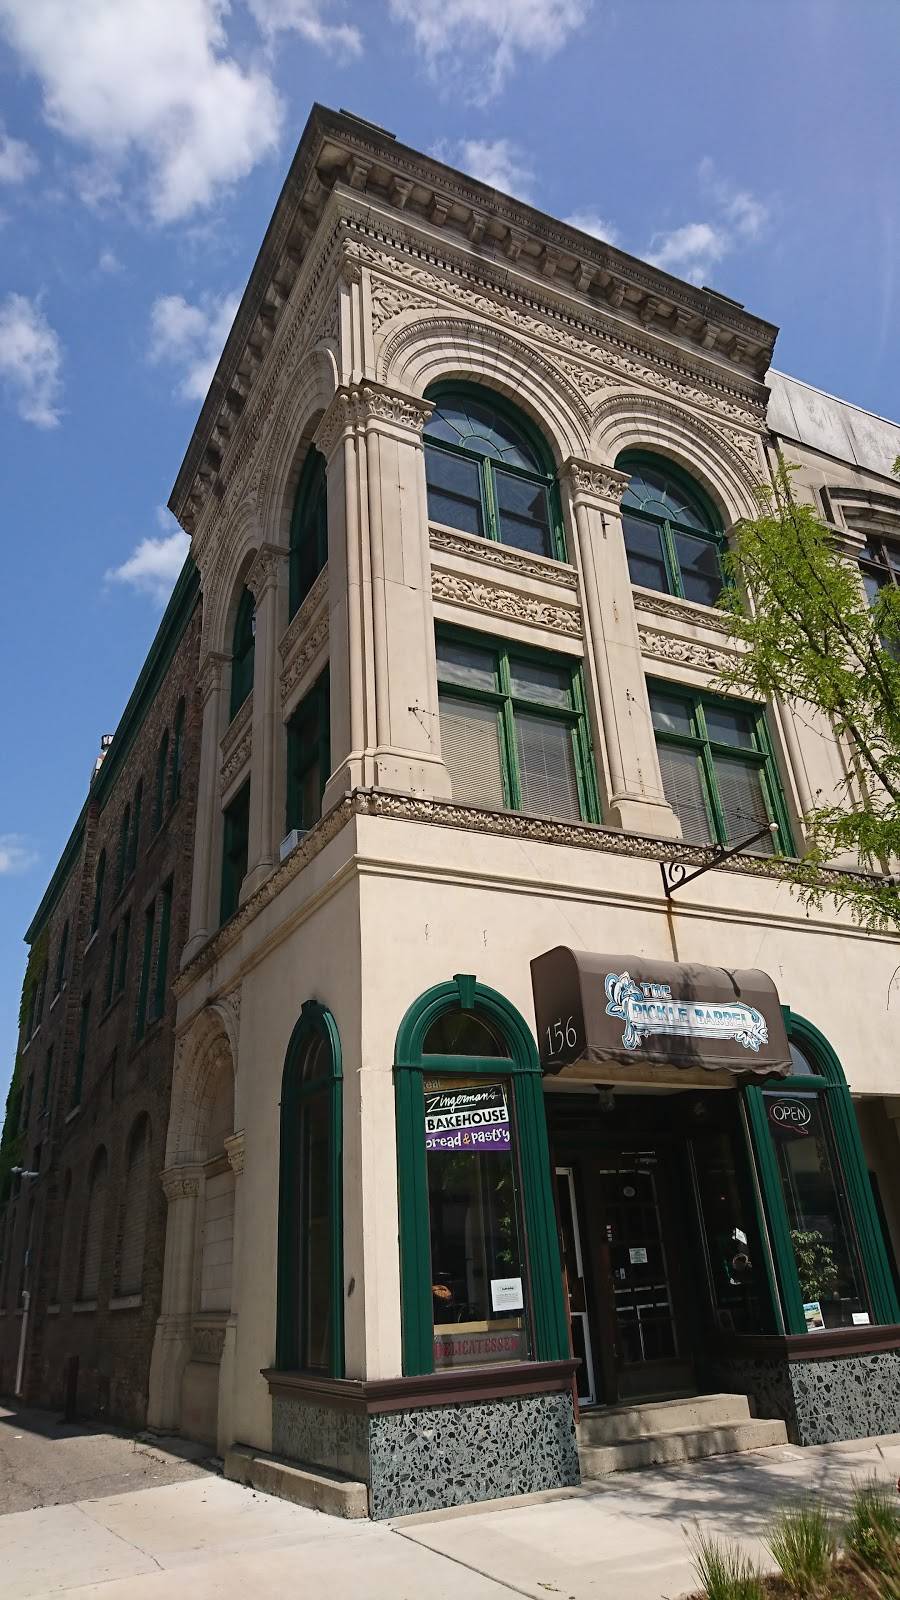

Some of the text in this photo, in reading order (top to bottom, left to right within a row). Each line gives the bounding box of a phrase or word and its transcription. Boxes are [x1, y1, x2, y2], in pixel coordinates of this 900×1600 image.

[640, 982, 672, 1000] THE
[632, 1002, 752, 1028] PICKLE BARREL
[545, 1015, 577, 1056] 156
[426, 1087, 498, 1114] Zingerman's
[427, 1109, 507, 1131] BAKEHOUSE
[773, 1105, 806, 1121] OPEN
[471, 1128, 510, 1144] pastry
